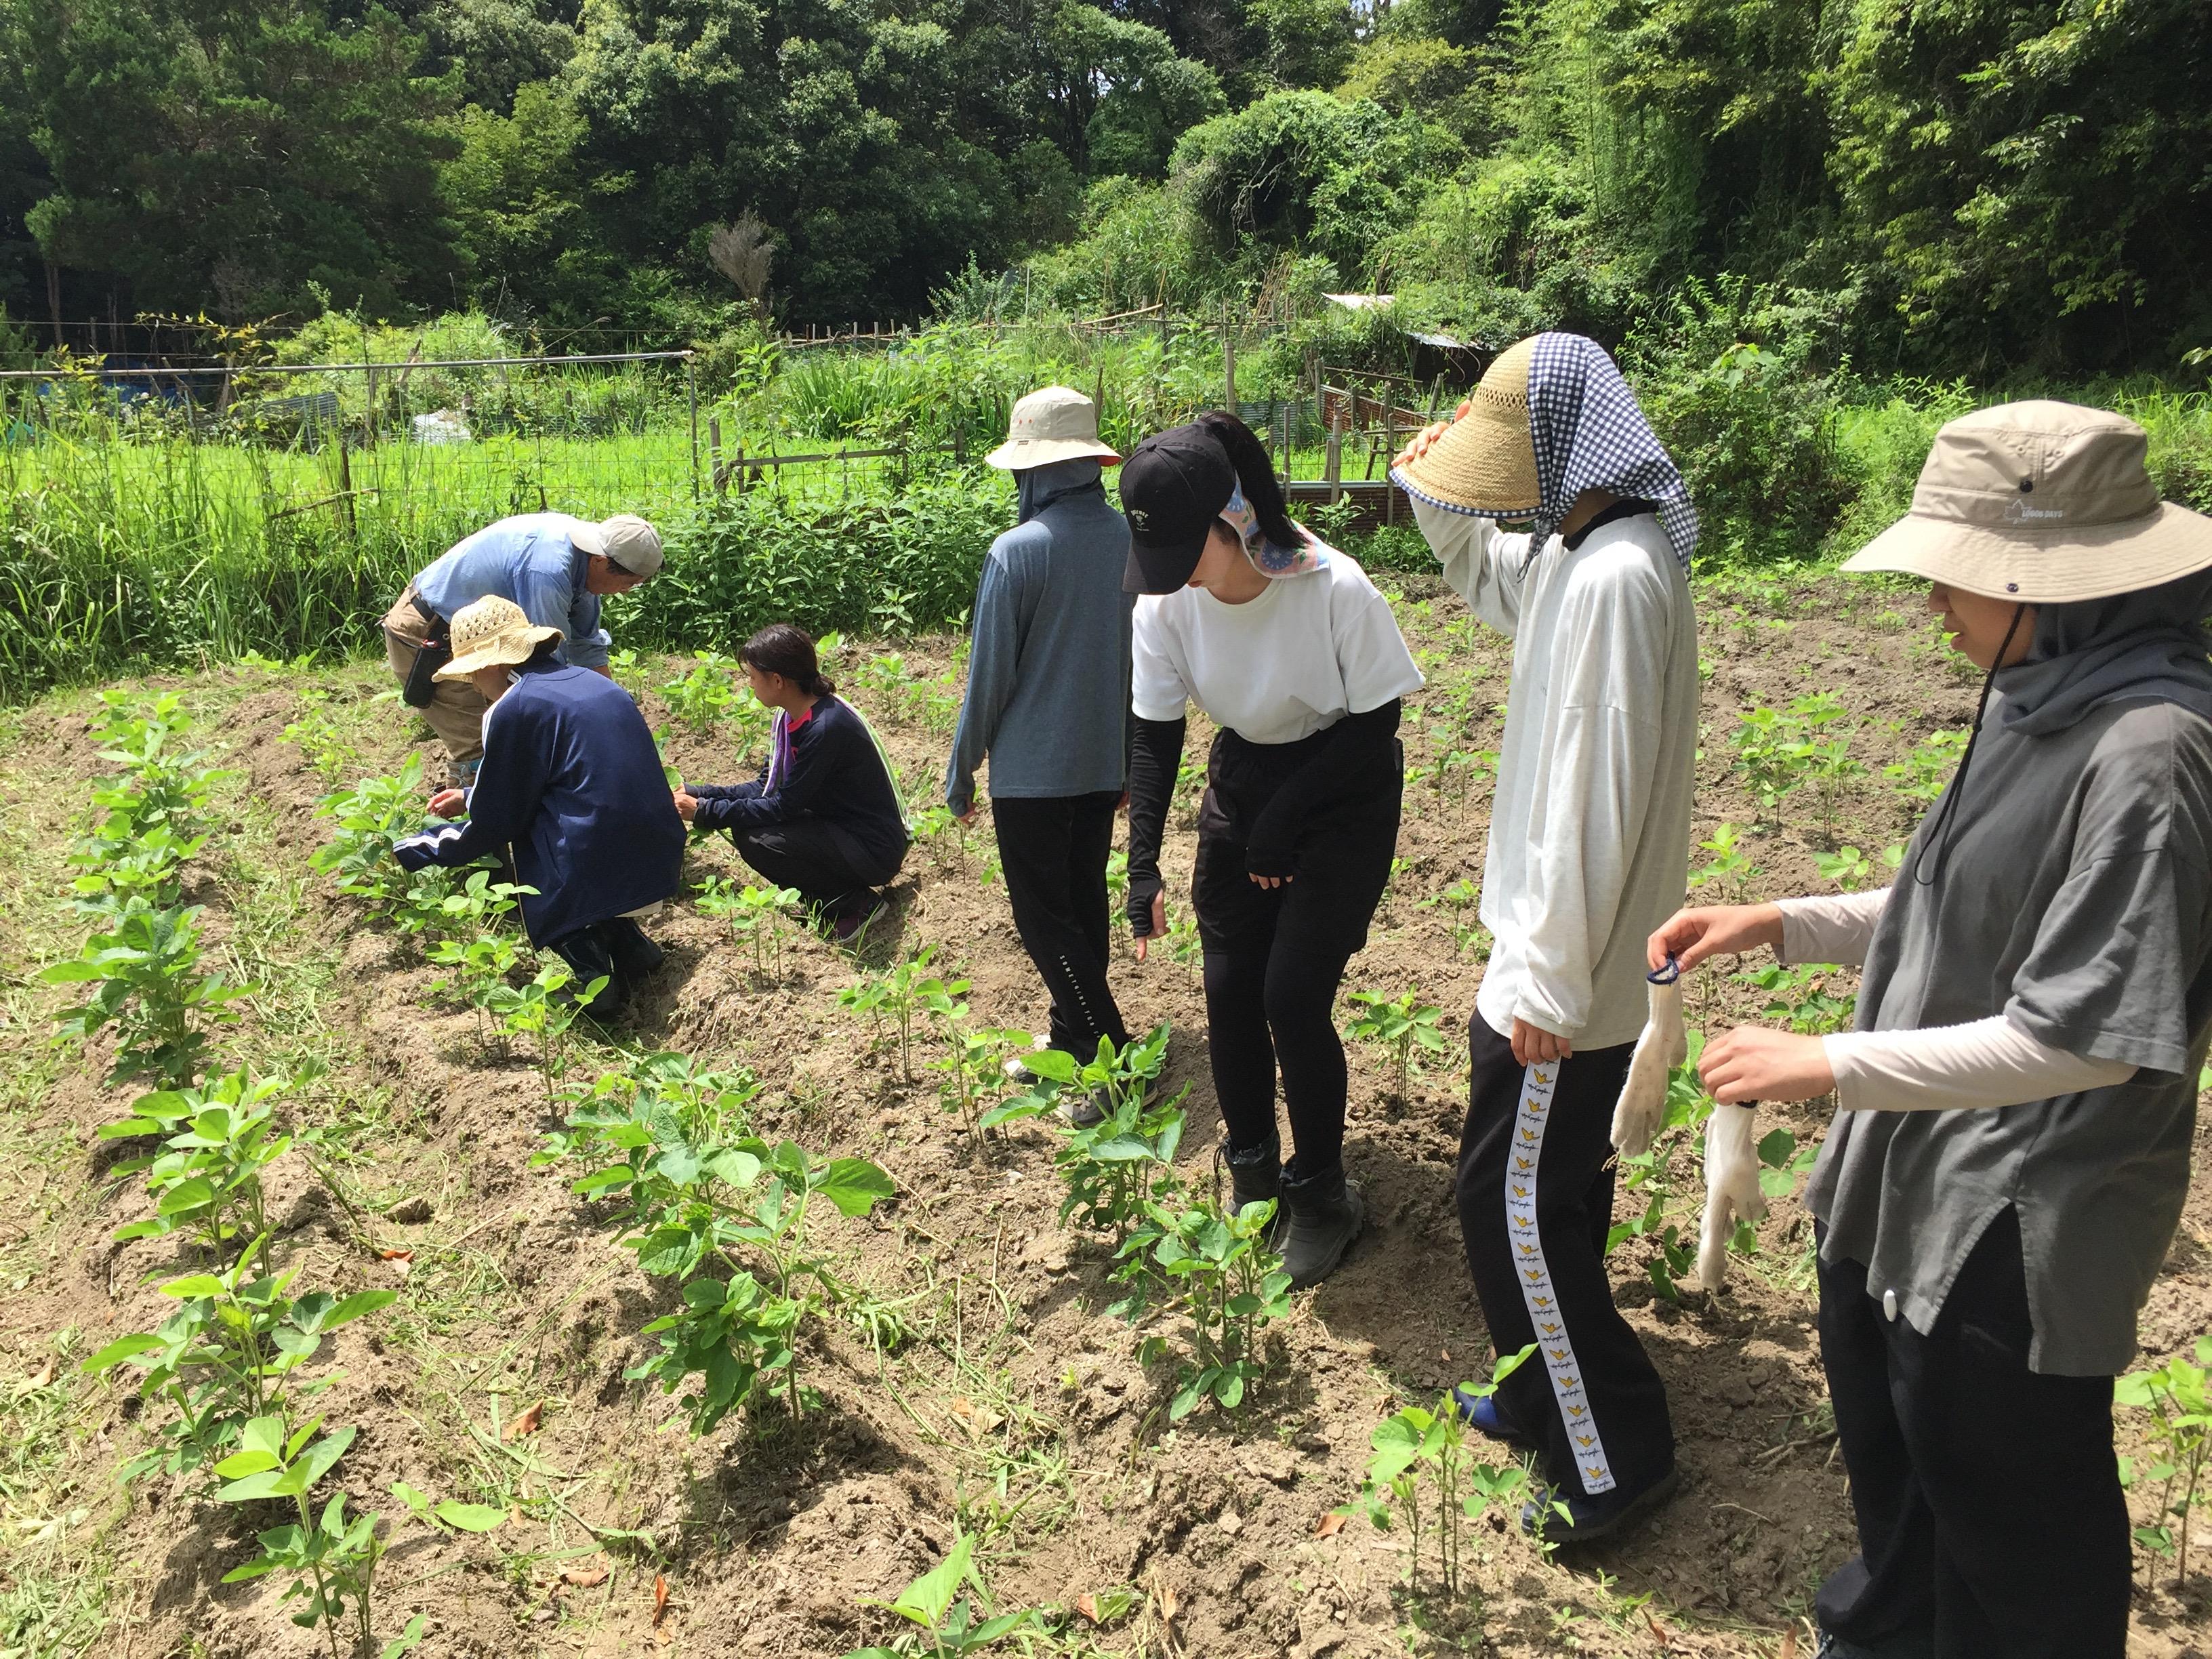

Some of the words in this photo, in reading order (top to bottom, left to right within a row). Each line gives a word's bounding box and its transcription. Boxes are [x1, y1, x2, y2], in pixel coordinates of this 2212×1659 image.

[2022, 510, 2043, 518] LOGOS
[2044, 510, 2063, 518] DAYS
[1059, 955, 1086, 1006] SOMETHING
[1084, 1010, 1094, 1026] FOR
